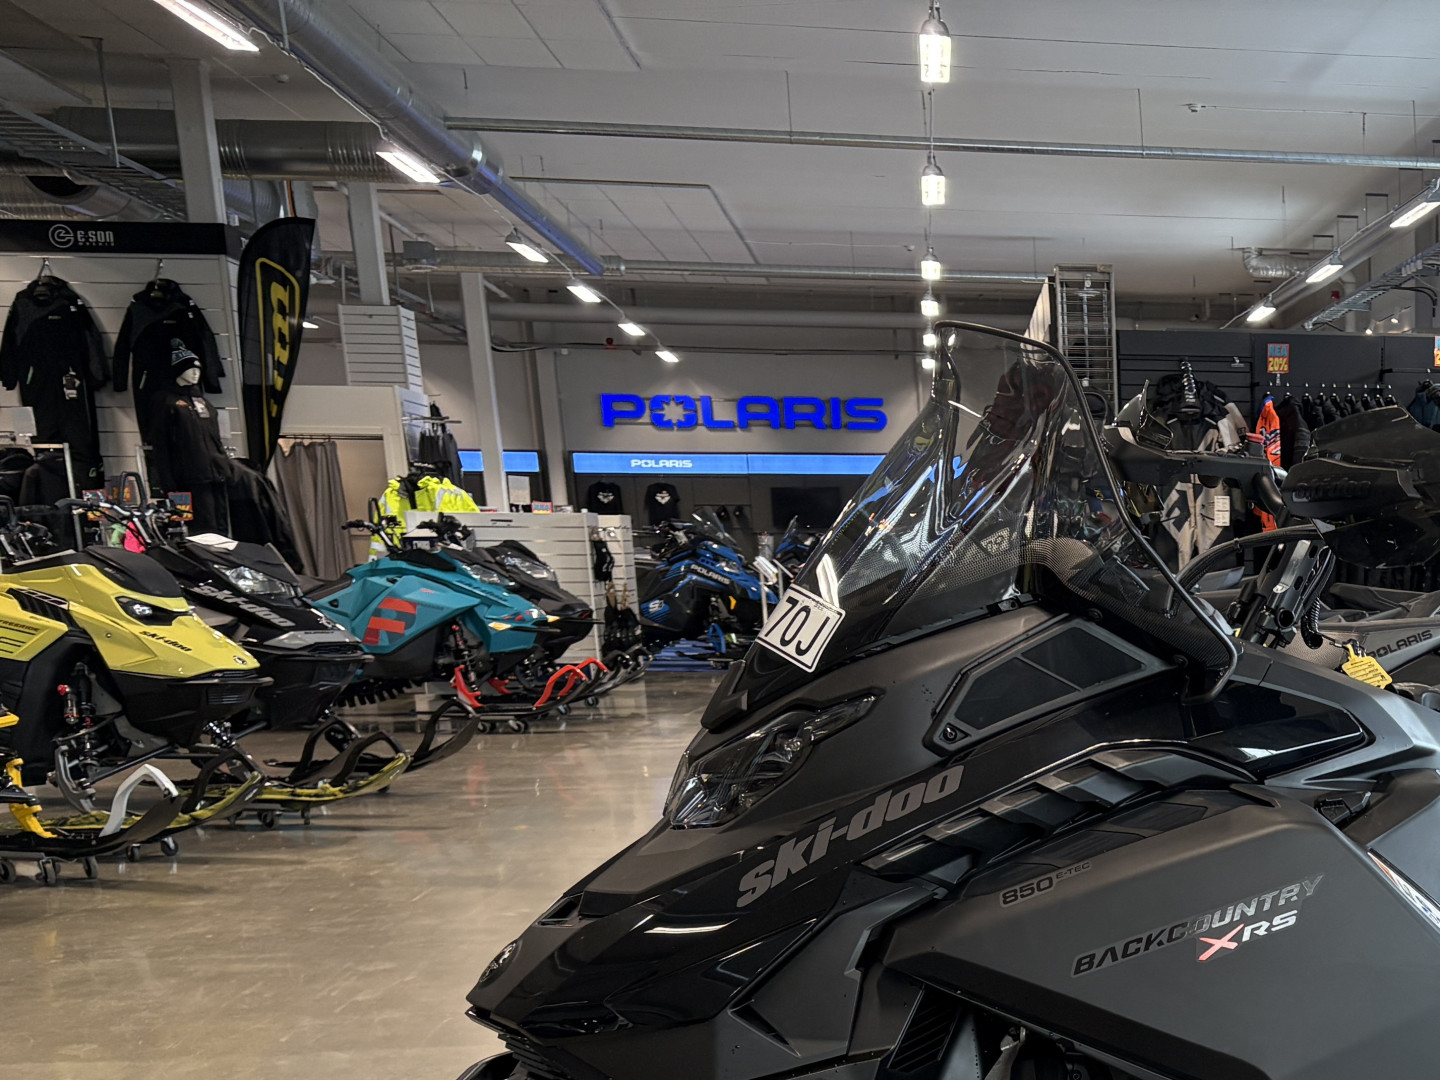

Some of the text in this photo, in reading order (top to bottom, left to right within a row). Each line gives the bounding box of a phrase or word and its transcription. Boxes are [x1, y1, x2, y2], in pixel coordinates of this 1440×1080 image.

[1268, 357, 1288, 371] 20%
[1269, 345, 1287, 356] REA
[601, 393, 888, 431] POLARIS
[630, 459, 693, 468] POLARIS
[691, 563, 731, 585] POLARIS
[197, 585, 296, 627] ski-doo
[764, 596, 831, 656] 70J
[139, 630, 193, 652] ski-doo
[736, 765, 965, 908] ski-doo
[1002, 862, 1090, 905] 850 E-TEC
[1073, 874, 1325, 976] BACKCOUNTRY
[1198, 909, 1298, 961] XRS
